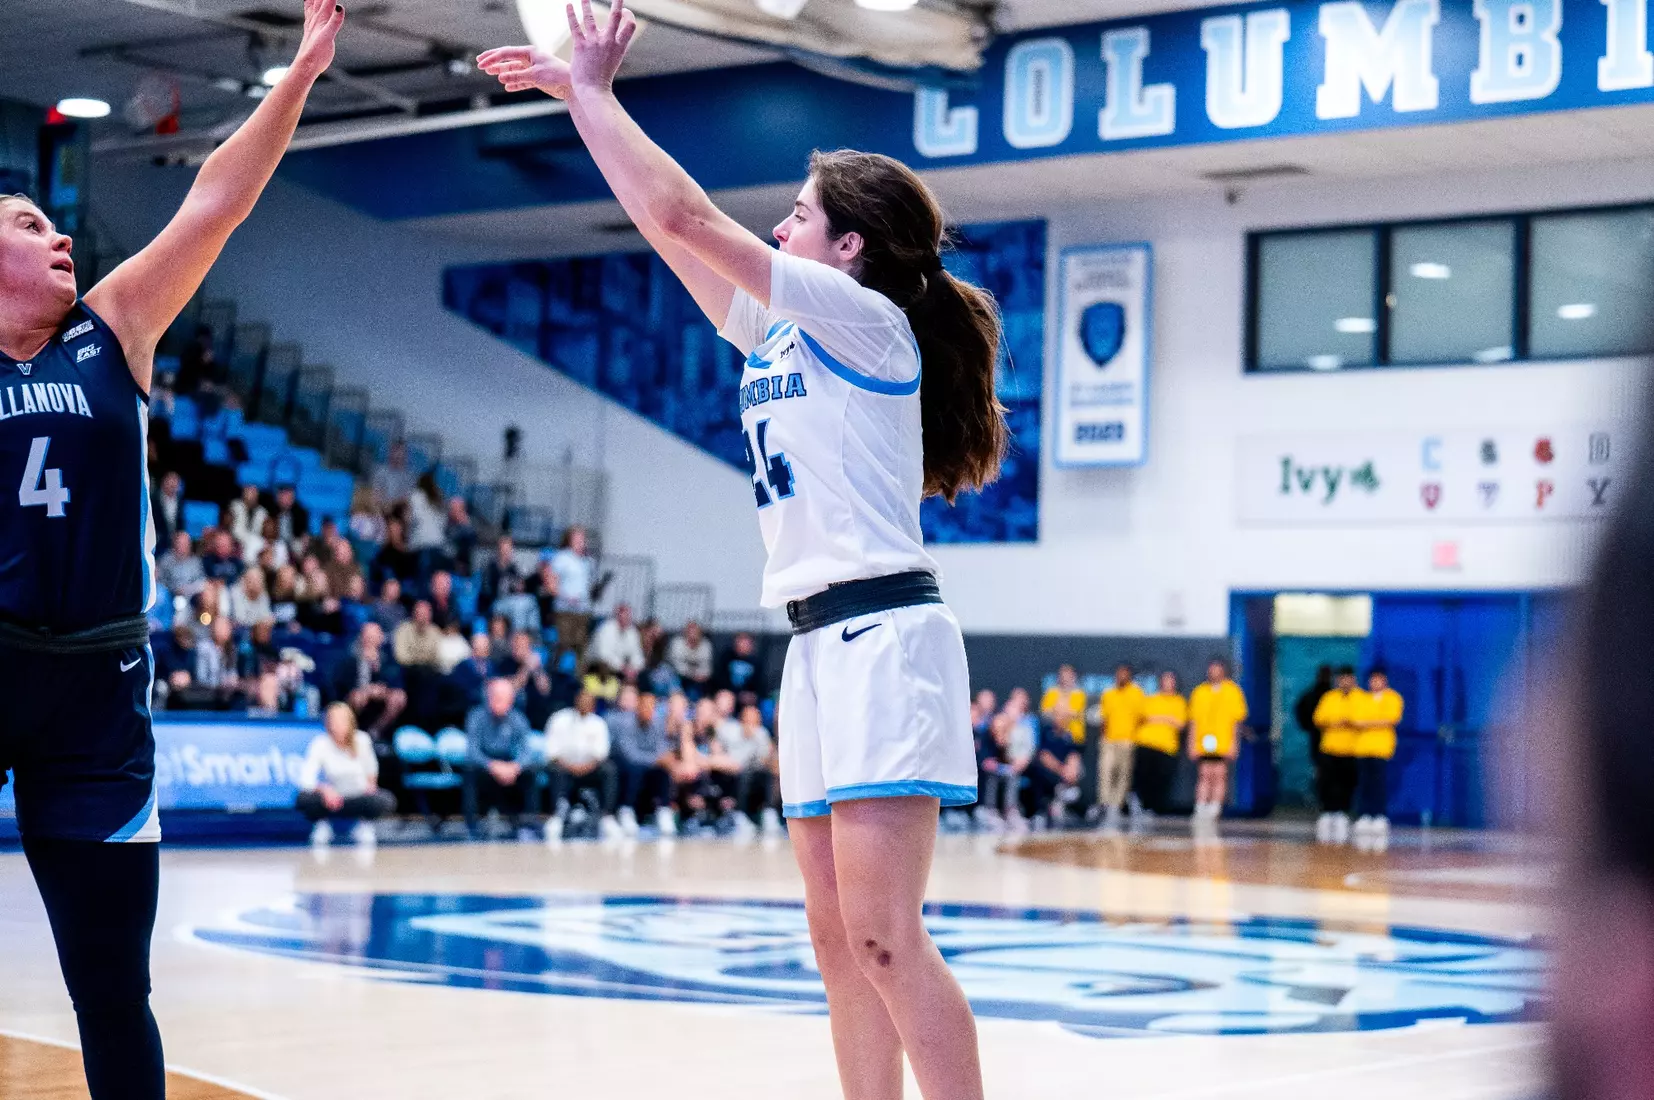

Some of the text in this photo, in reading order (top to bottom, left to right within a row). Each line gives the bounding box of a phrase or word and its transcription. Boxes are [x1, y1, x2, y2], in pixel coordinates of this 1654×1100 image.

[77, 344, 94, 355] BIG
[77, 347, 101, 361] EAST
[18, 436, 71, 518] 4
[1279, 455, 1344, 504] Ivy
